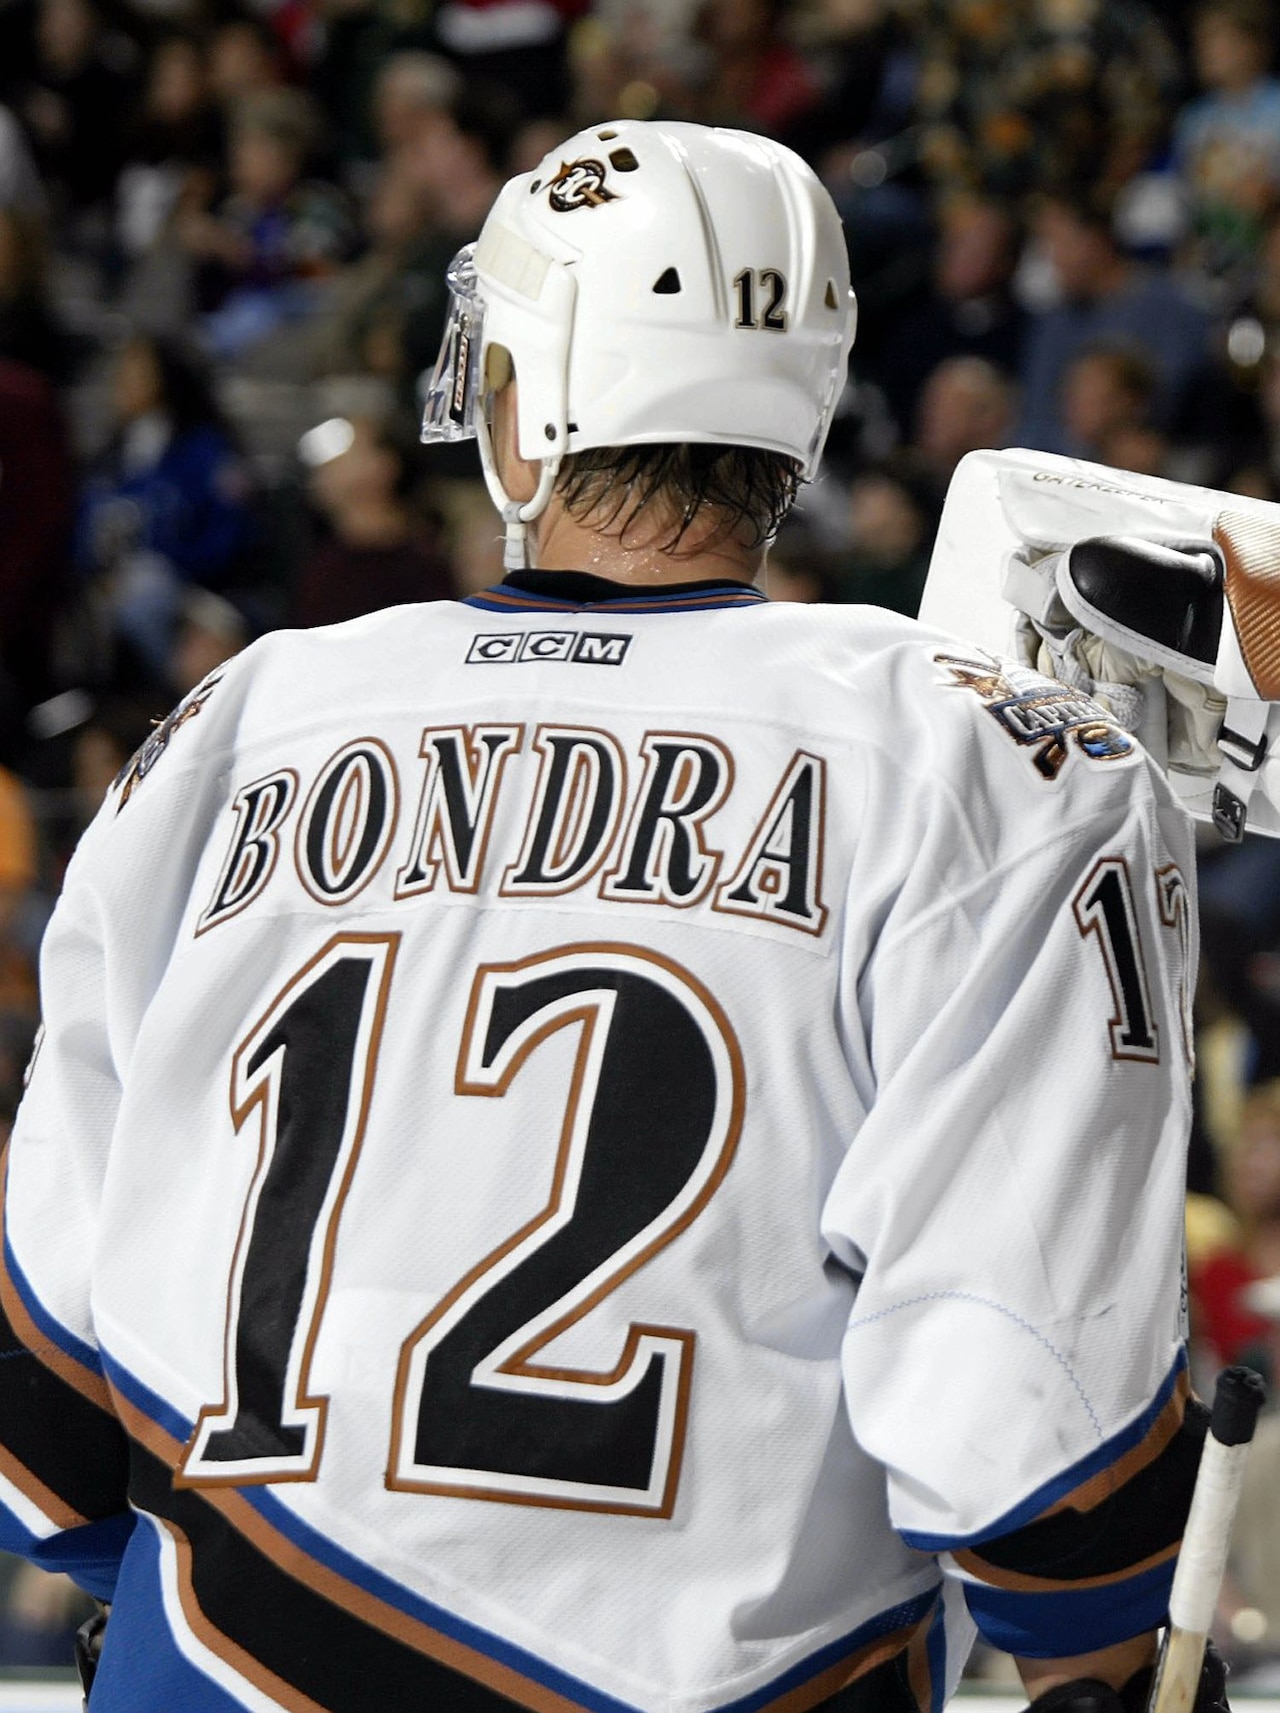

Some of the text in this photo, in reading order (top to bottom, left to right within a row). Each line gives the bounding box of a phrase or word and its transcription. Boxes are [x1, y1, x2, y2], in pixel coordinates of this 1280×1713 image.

[733, 267, 789, 332] 12
[470, 633, 630, 662] CCM
[195, 723, 828, 938] BONDRA
[172, 930, 748, 1519] 12
